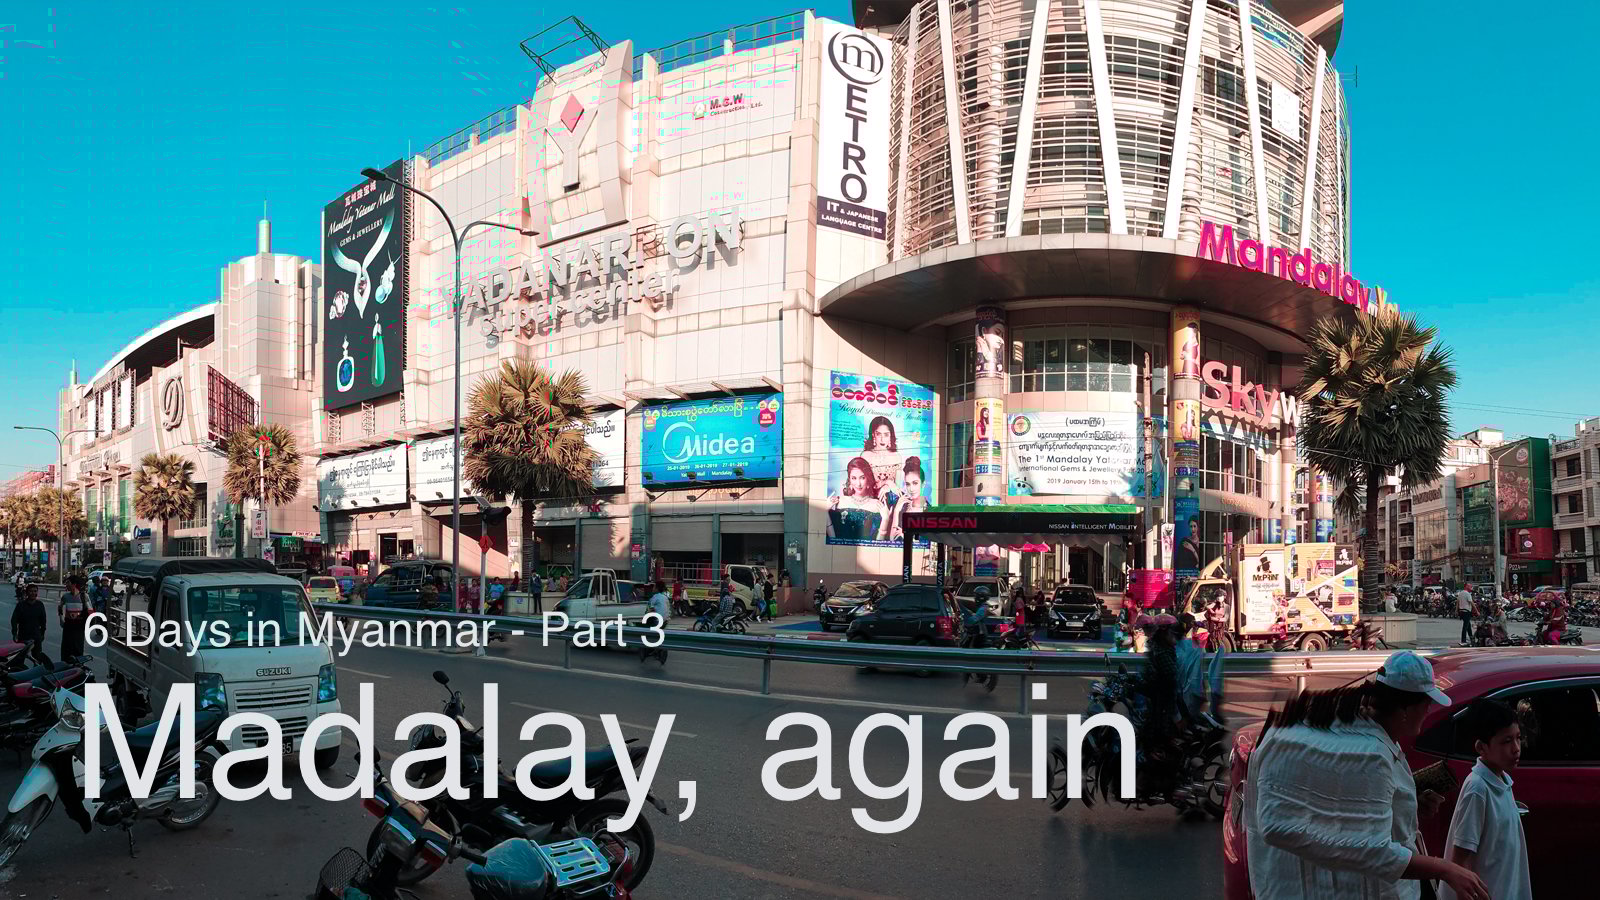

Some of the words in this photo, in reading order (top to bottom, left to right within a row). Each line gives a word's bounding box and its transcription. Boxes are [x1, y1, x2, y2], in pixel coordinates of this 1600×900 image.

[826, 200, 840, 212] IT
[846, 210, 879, 223] JAPANESE
[821, 214, 857, 227] LANGUAGE
[857, 222, 883, 234] CENTRE
[839, 402, 865, 416] Royal
[668, 427, 755, 460] Midea
[1018, 455, 1032, 464] The
[1046, 455, 1093, 465] Mandalay
[1088, 465, 1121, 474] Jewellery
[1062, 478, 1087, 486] January
[907, 516, 977, 529] NISSAN
[1108, 522, 1137, 531] MOBILITY
[256, 667, 292, 676] SUZUKI
